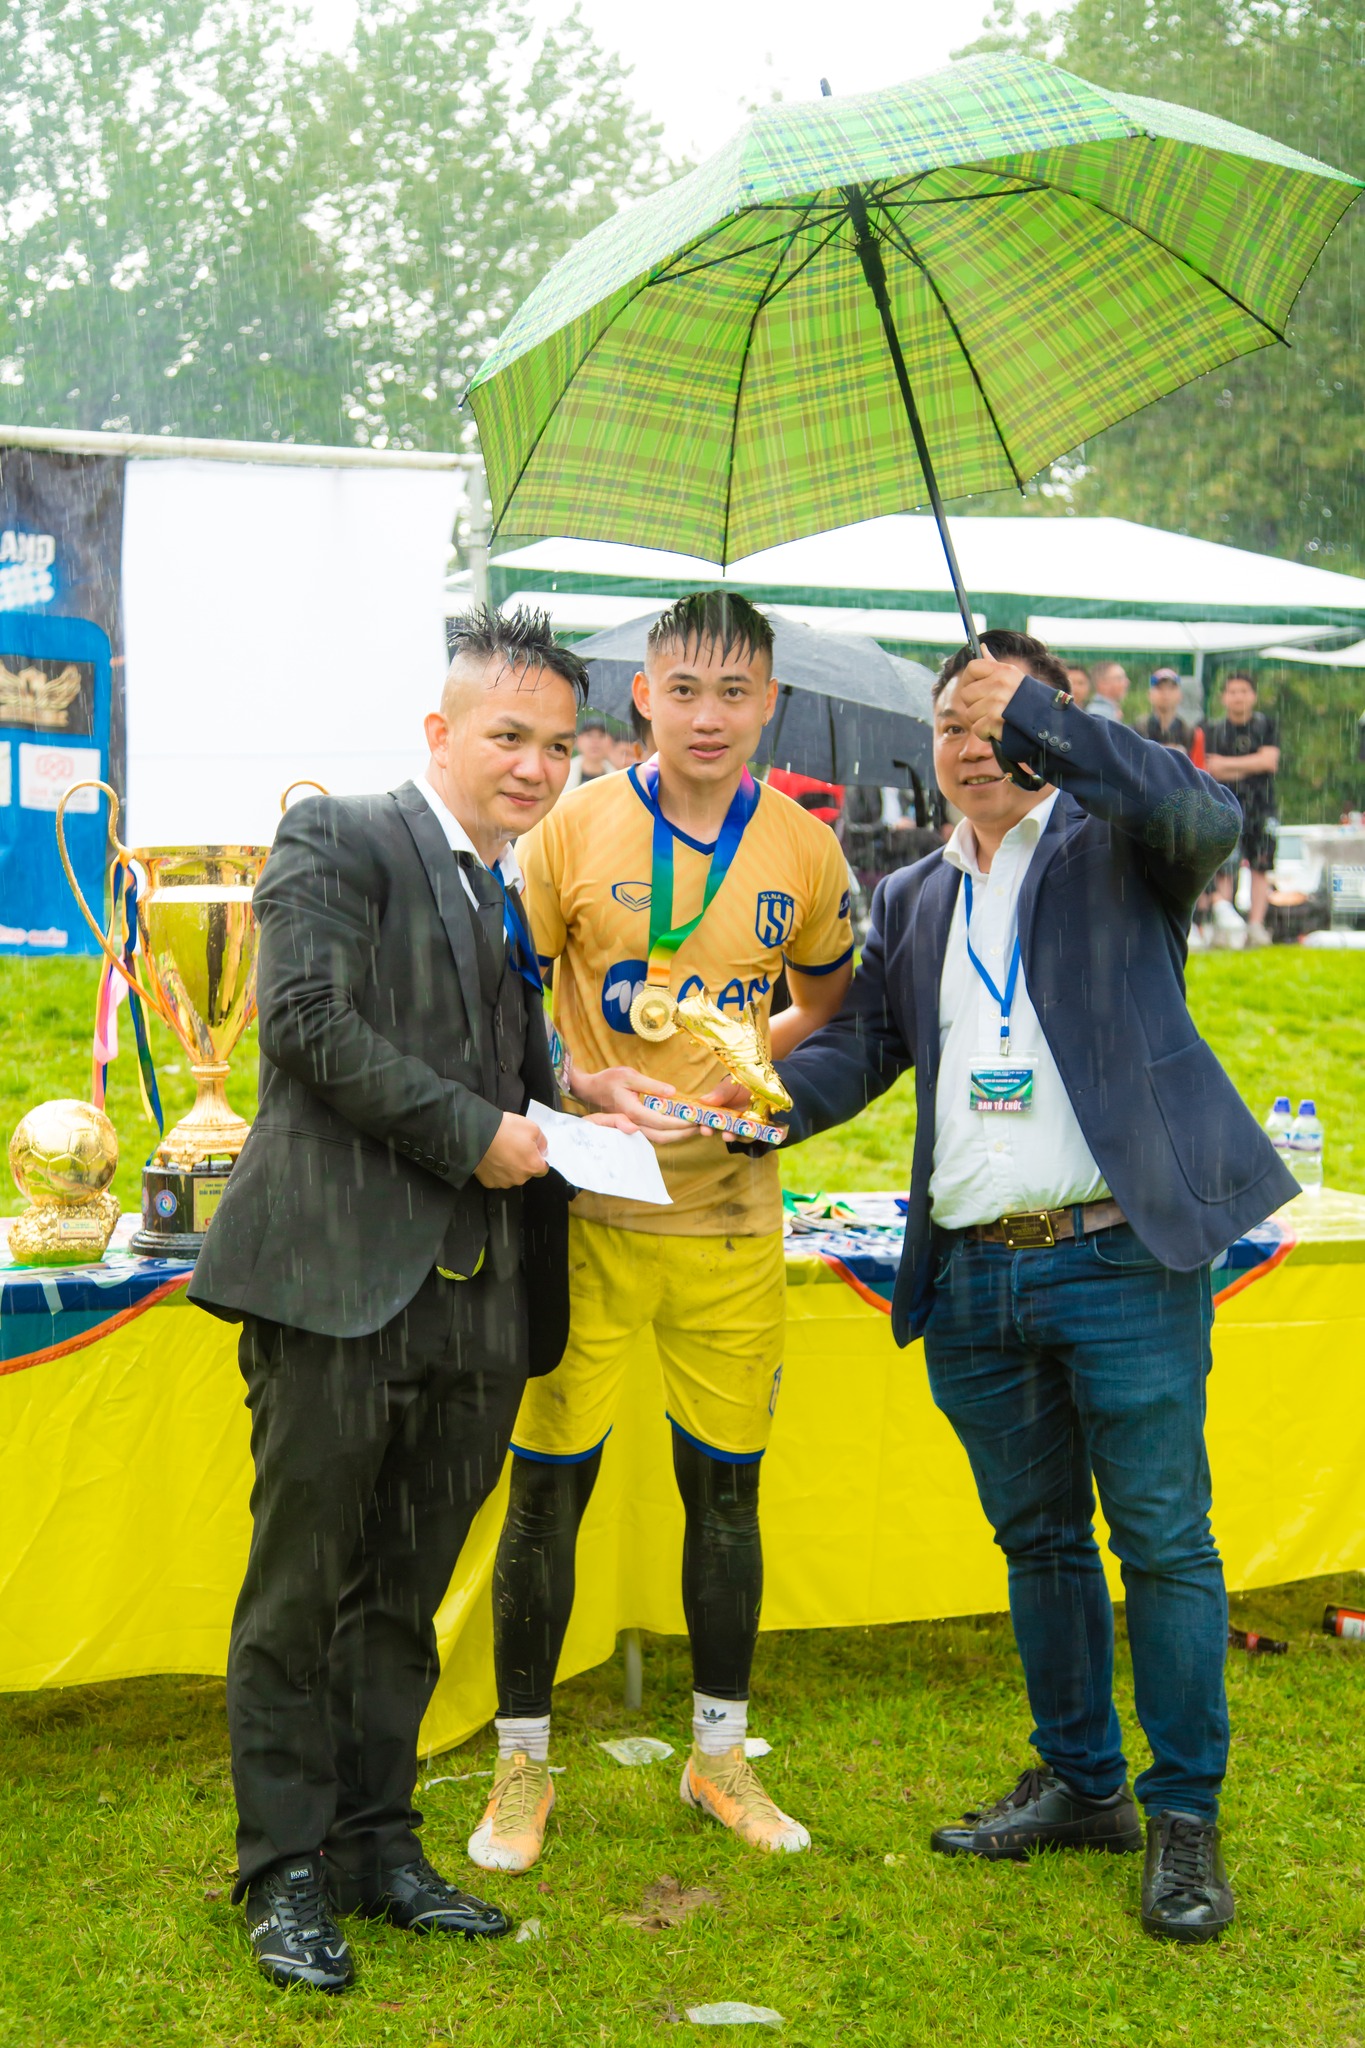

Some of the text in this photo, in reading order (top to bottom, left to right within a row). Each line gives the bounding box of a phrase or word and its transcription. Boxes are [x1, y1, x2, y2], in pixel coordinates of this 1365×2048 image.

[0, 530, 56, 564] AND
[760, 893, 793, 904] SLNA FC
[978, 1101, 992, 1110] BAN
[993, 1097, 1004, 1110] TỔ
[290, 1868, 309, 1877] BOSS
